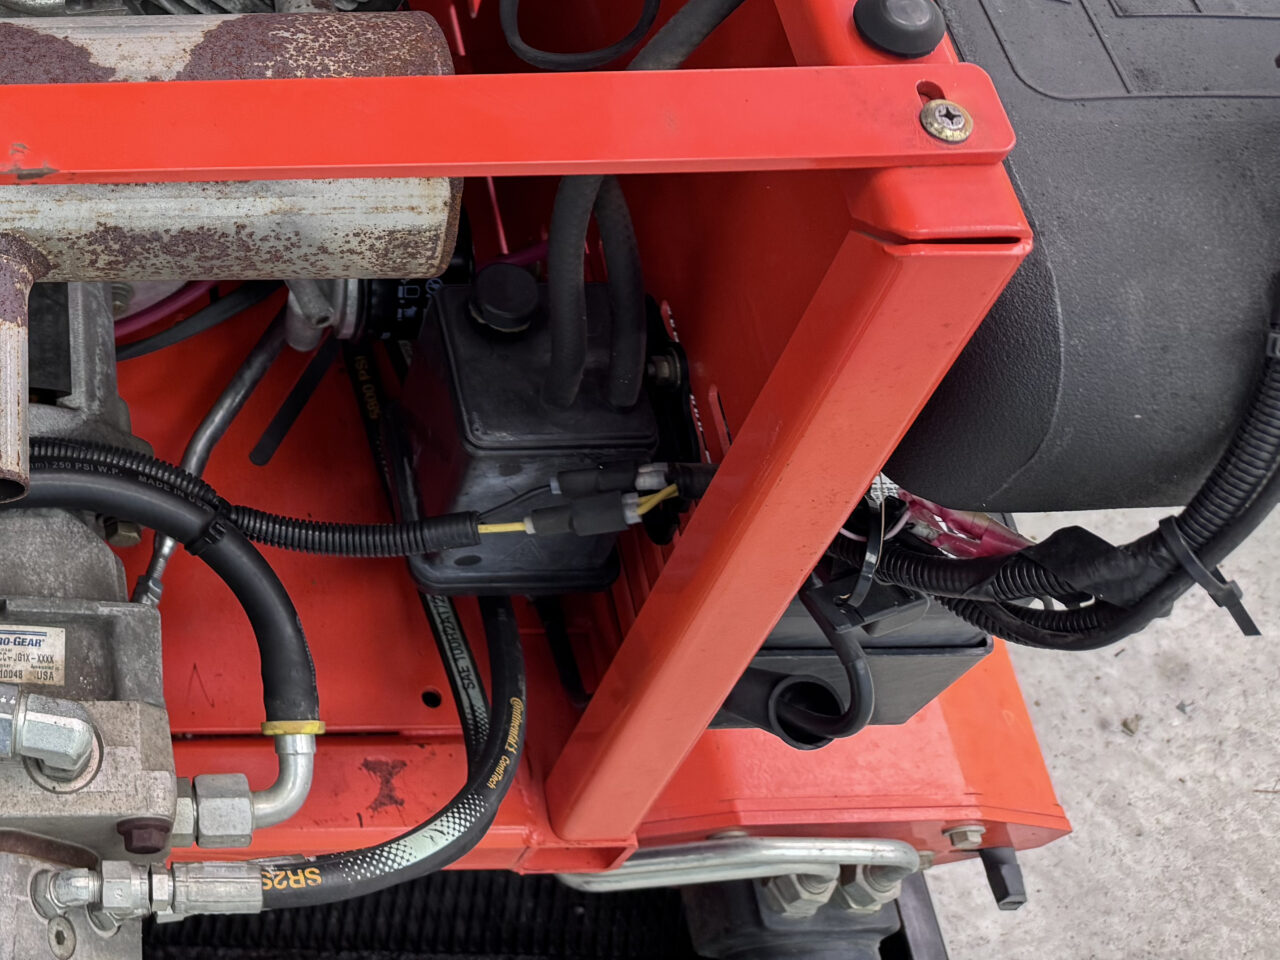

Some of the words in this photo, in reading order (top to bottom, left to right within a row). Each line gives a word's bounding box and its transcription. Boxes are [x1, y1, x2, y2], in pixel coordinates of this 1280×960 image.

[52, 461, 70, 470] 250
[75, 462, 94, 472] PSI
[138, 474, 170, 492] MADE
[173, 488, 186, 498] IN
[36, 670, 55, 681] USA
[460, 665, 475, 690] SAE
[505, 697, 524, 753] Continental
[486, 755, 510, 791] ContiTech
